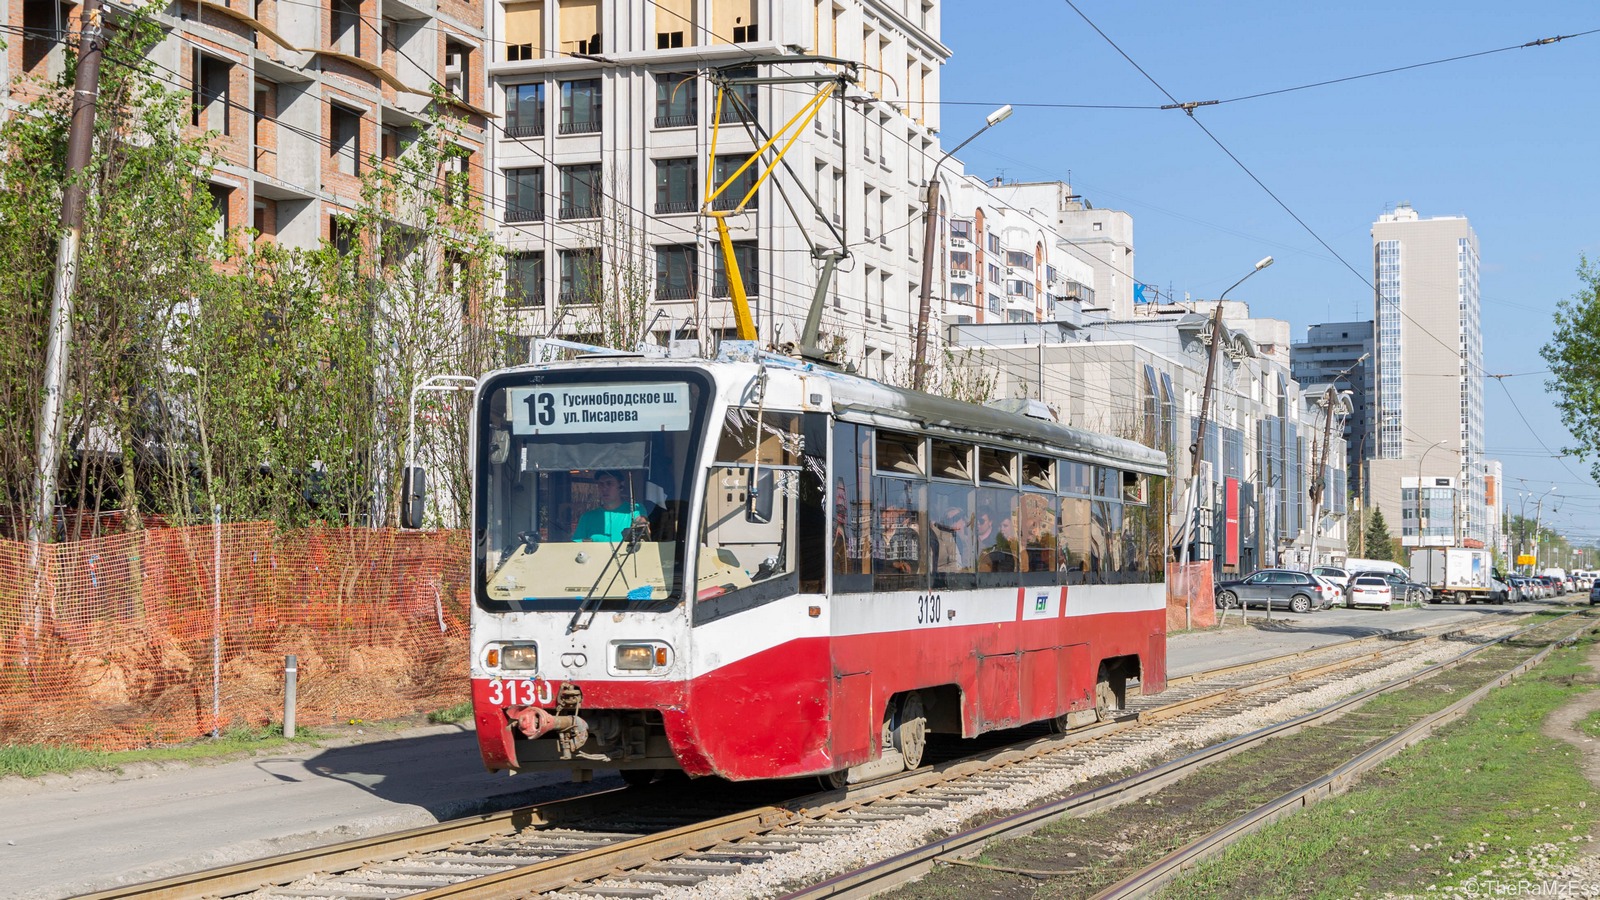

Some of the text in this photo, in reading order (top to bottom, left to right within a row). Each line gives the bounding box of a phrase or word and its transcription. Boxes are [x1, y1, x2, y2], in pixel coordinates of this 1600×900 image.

[523, 392, 556, 426] 13
[563, 391, 677, 407] Гусинобродское ш.
[563, 409, 638, 424] ул. Писарева
[918, 594, 941, 624] 3130
[488, 680, 553, 705] 3130
